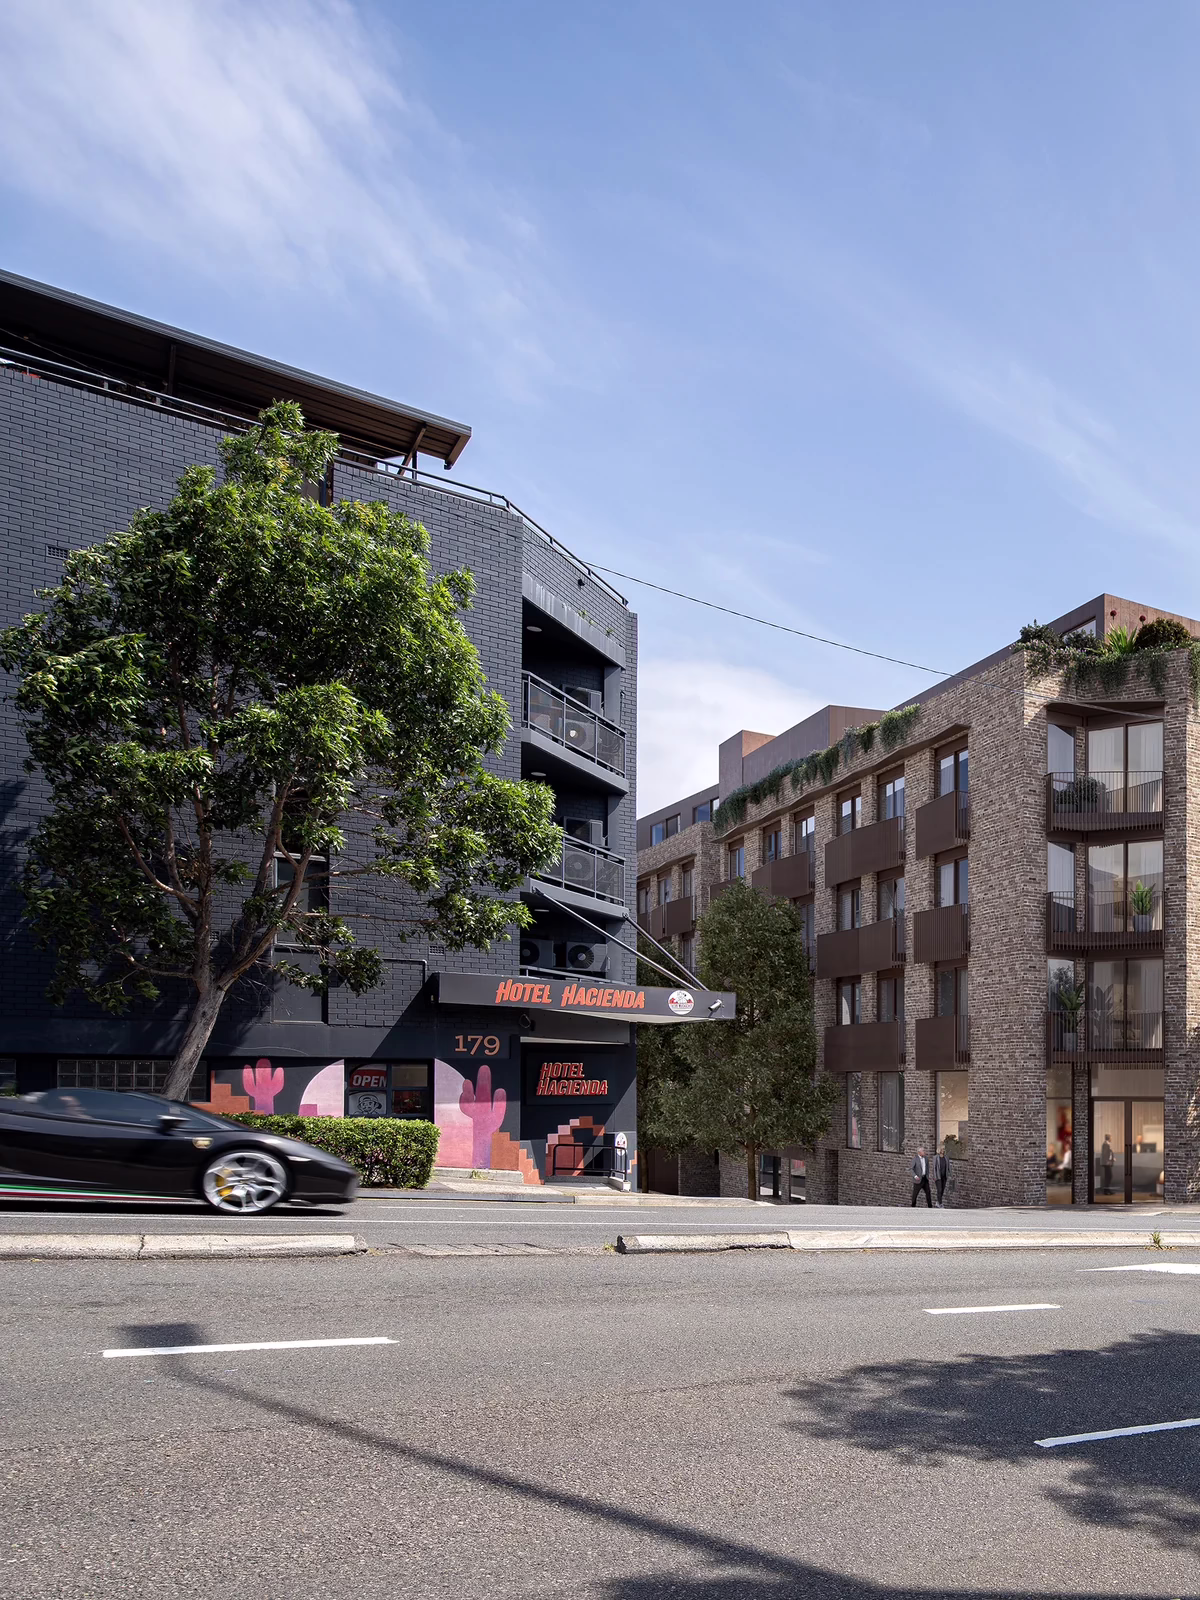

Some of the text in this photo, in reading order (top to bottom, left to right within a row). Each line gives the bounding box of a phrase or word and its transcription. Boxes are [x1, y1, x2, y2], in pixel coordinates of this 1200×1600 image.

[495, 979, 645, 1008] HOTEL HACIENDA
[455, 1035, 500, 1056] 179
[540, 1062, 585, 1079] HOTEL
[352, 1074, 387, 1087] OPEN
[536, 1077, 608, 1096] HACIENDA
